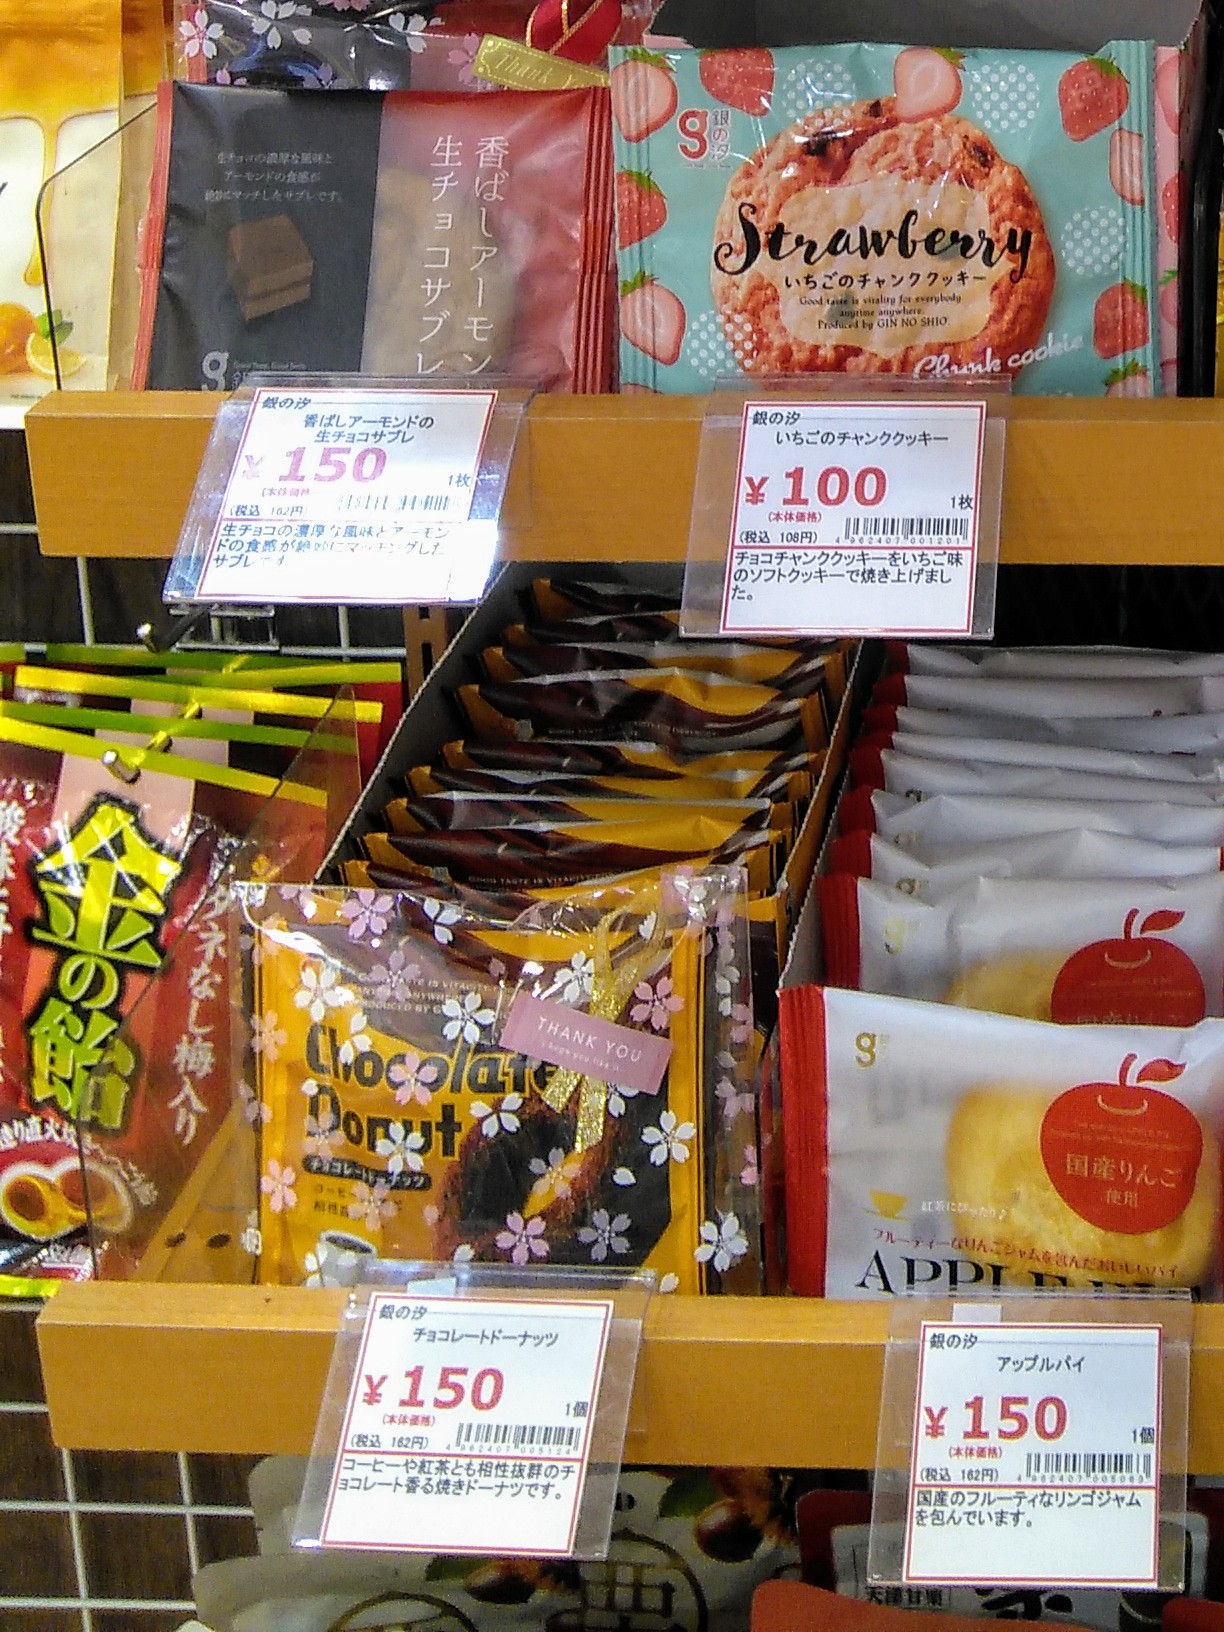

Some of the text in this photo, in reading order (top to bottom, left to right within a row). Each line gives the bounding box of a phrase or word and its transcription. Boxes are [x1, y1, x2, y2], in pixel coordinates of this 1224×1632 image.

[714, 202, 1033, 281] Strawberry
[784, 271, 988, 289] いちごのチャンククッキー
[304, 414, 434, 429] 香ばしアーモンドの
[752, 411, 801, 426] 銀の汐
[314, 430, 414, 443] 生チョコサブレ
[776, 432, 949, 446] いちごのチャンククッキー
[448, 474, 471, 487] 1枚
[950, 495, 974, 509] 1枚
[768, 512, 822, 523] (本体価格)
[734, 552, 963, 567] チョコチャンククッキーをいちご味
[734, 568, 952, 584] のソフトクッキーで焼き上げまし
[731, 586, 754, 601] た。
[537, 1017, 598, 1049] THANK
[606, 1040, 642, 1062] YOU
[1065, 1153, 1182, 1190] 国産りんご
[412, 1328, 559, 1346] チョコレートドーナッツ
[929, 1334, 978, 1349] 銀の汐
[998, 1356, 1086, 1372] アップルパイ
[565, 1402, 588, 1417] 1個
[1132, 1427, 1155, 1444] 1個
[949, 1446, 1003, 1459] (本体価格)
[342, 1458, 575, 1479] コーヒーや紅茶とも相性抜群のチ
[338, 1477, 562, 1500] ョコレート香る焼きドーナツです。
[916, 1490, 1141, 1508] 国産のフルーティなリンゴジャム
[915, 1509, 1033, 1527] を包んでいます。
